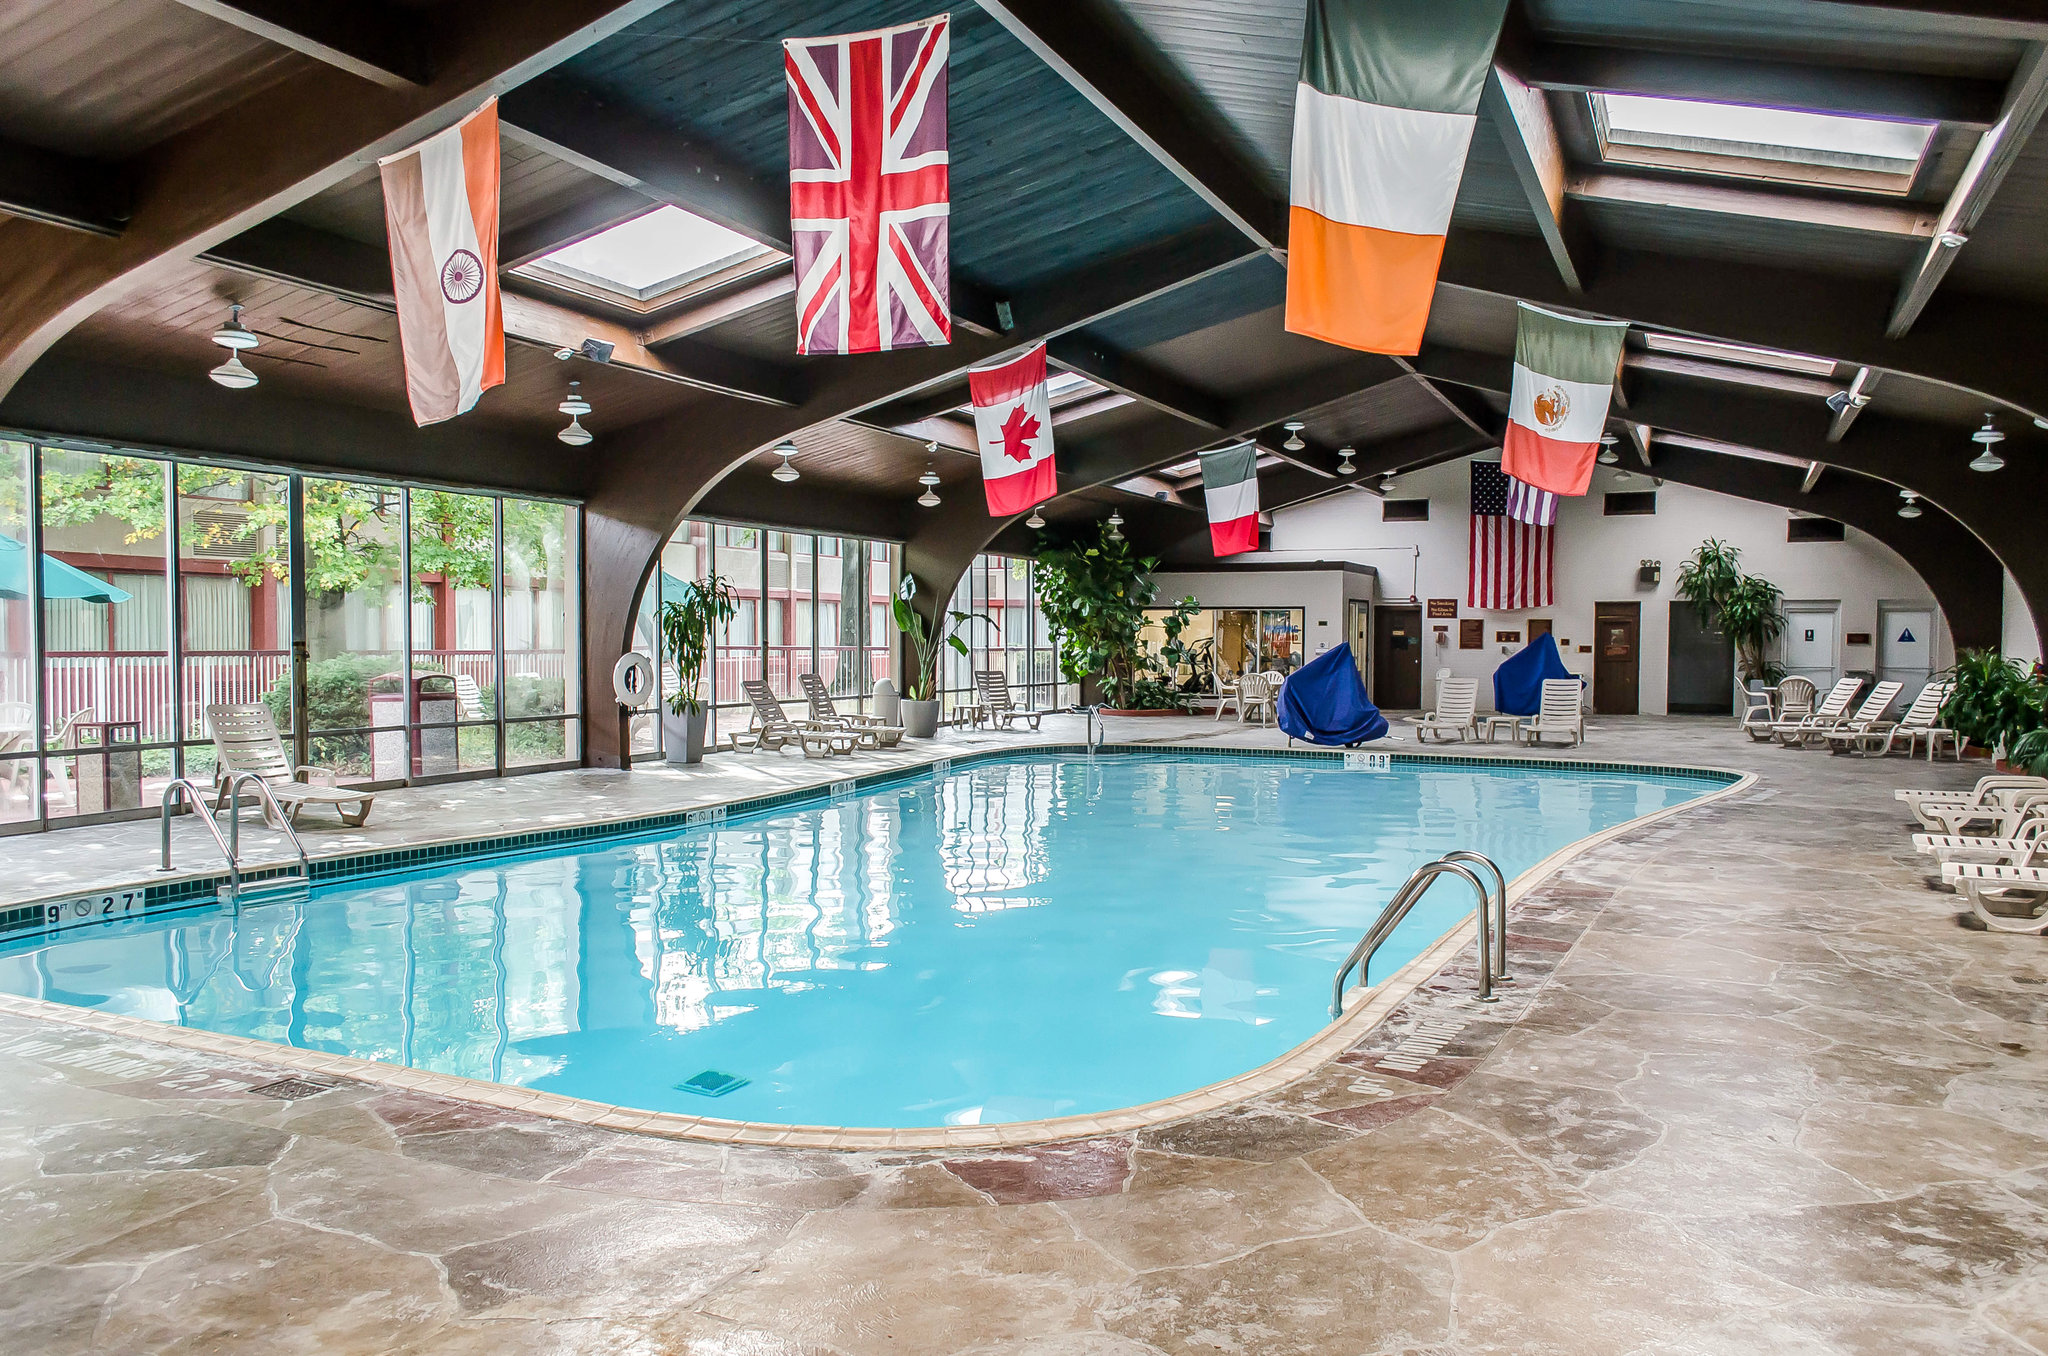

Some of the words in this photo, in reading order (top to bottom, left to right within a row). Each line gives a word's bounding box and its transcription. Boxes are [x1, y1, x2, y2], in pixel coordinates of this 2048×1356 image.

[1395, 1020, 1466, 1055] DIVING
[43, 1043, 166, 1079] DIVING
[1374, 1054, 1428, 1073] NO
